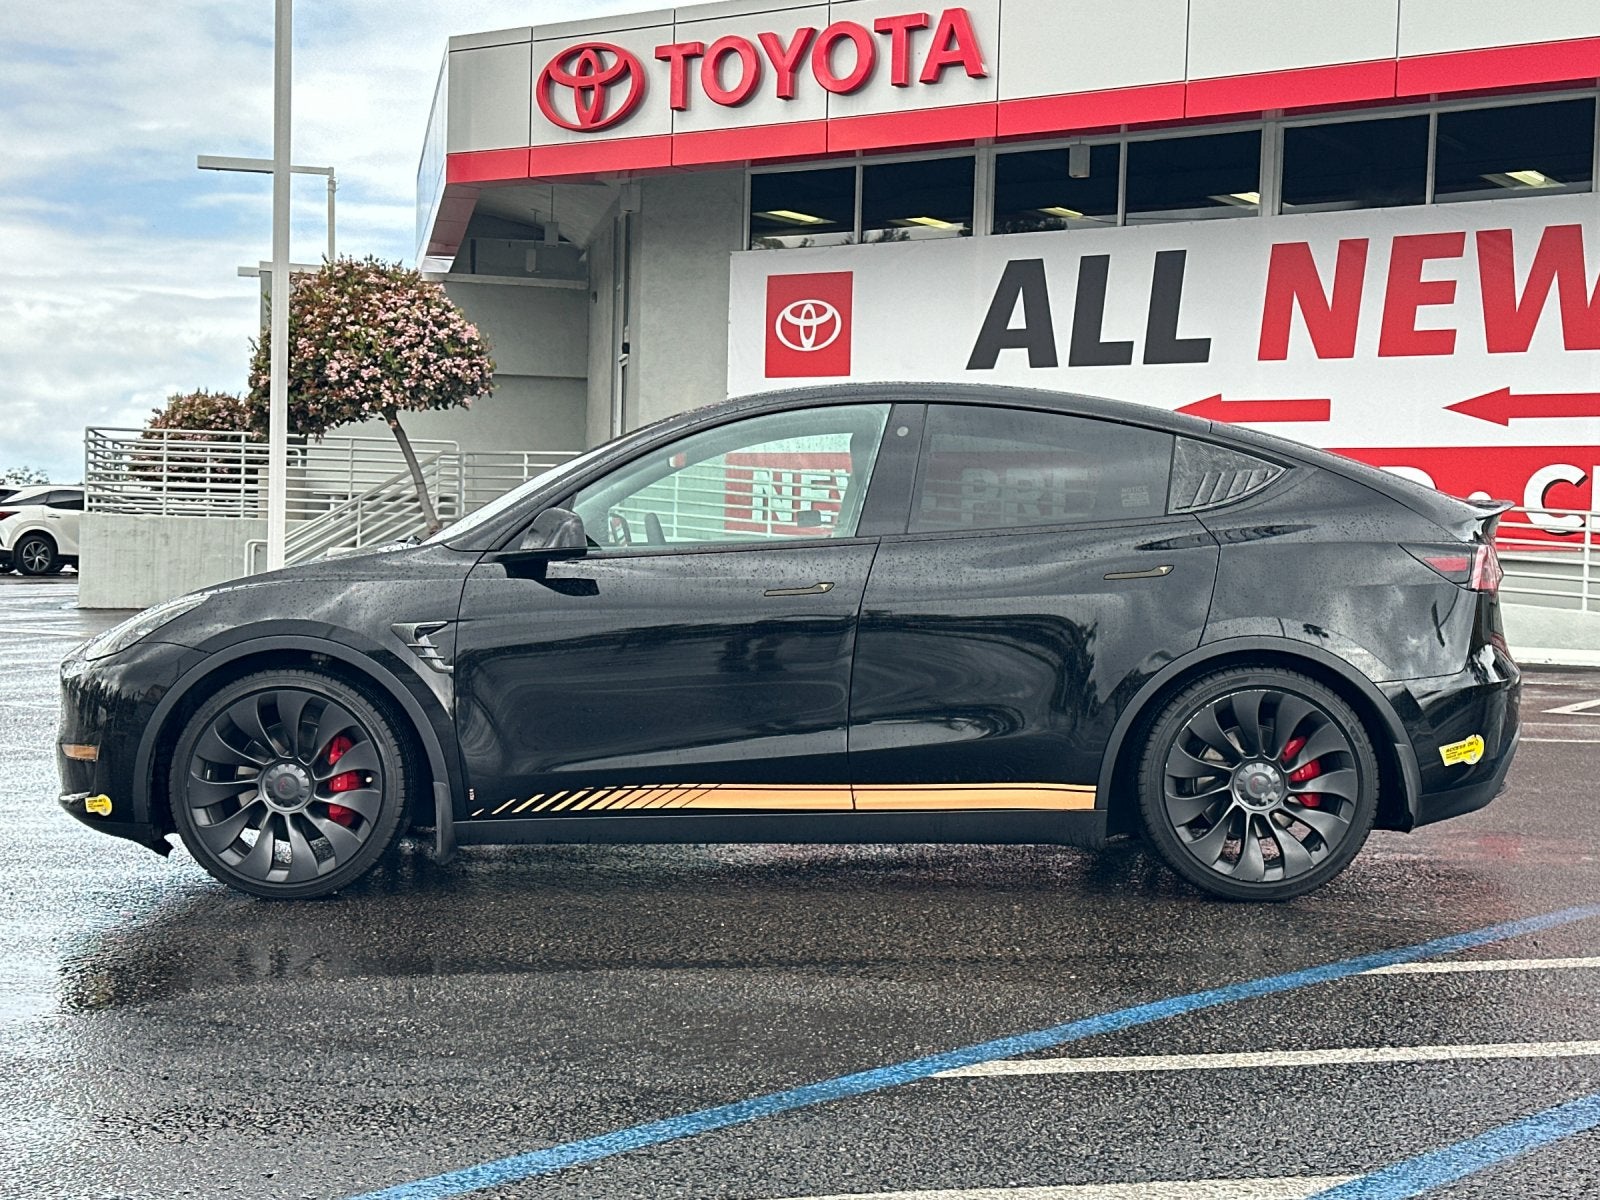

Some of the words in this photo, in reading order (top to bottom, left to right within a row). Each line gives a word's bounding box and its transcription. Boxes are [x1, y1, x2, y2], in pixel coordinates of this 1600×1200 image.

[655, 7, 988, 111] TOYOTA
[966, 250, 1212, 370] ALL
[1258, 223, 1600, 362] NEW
